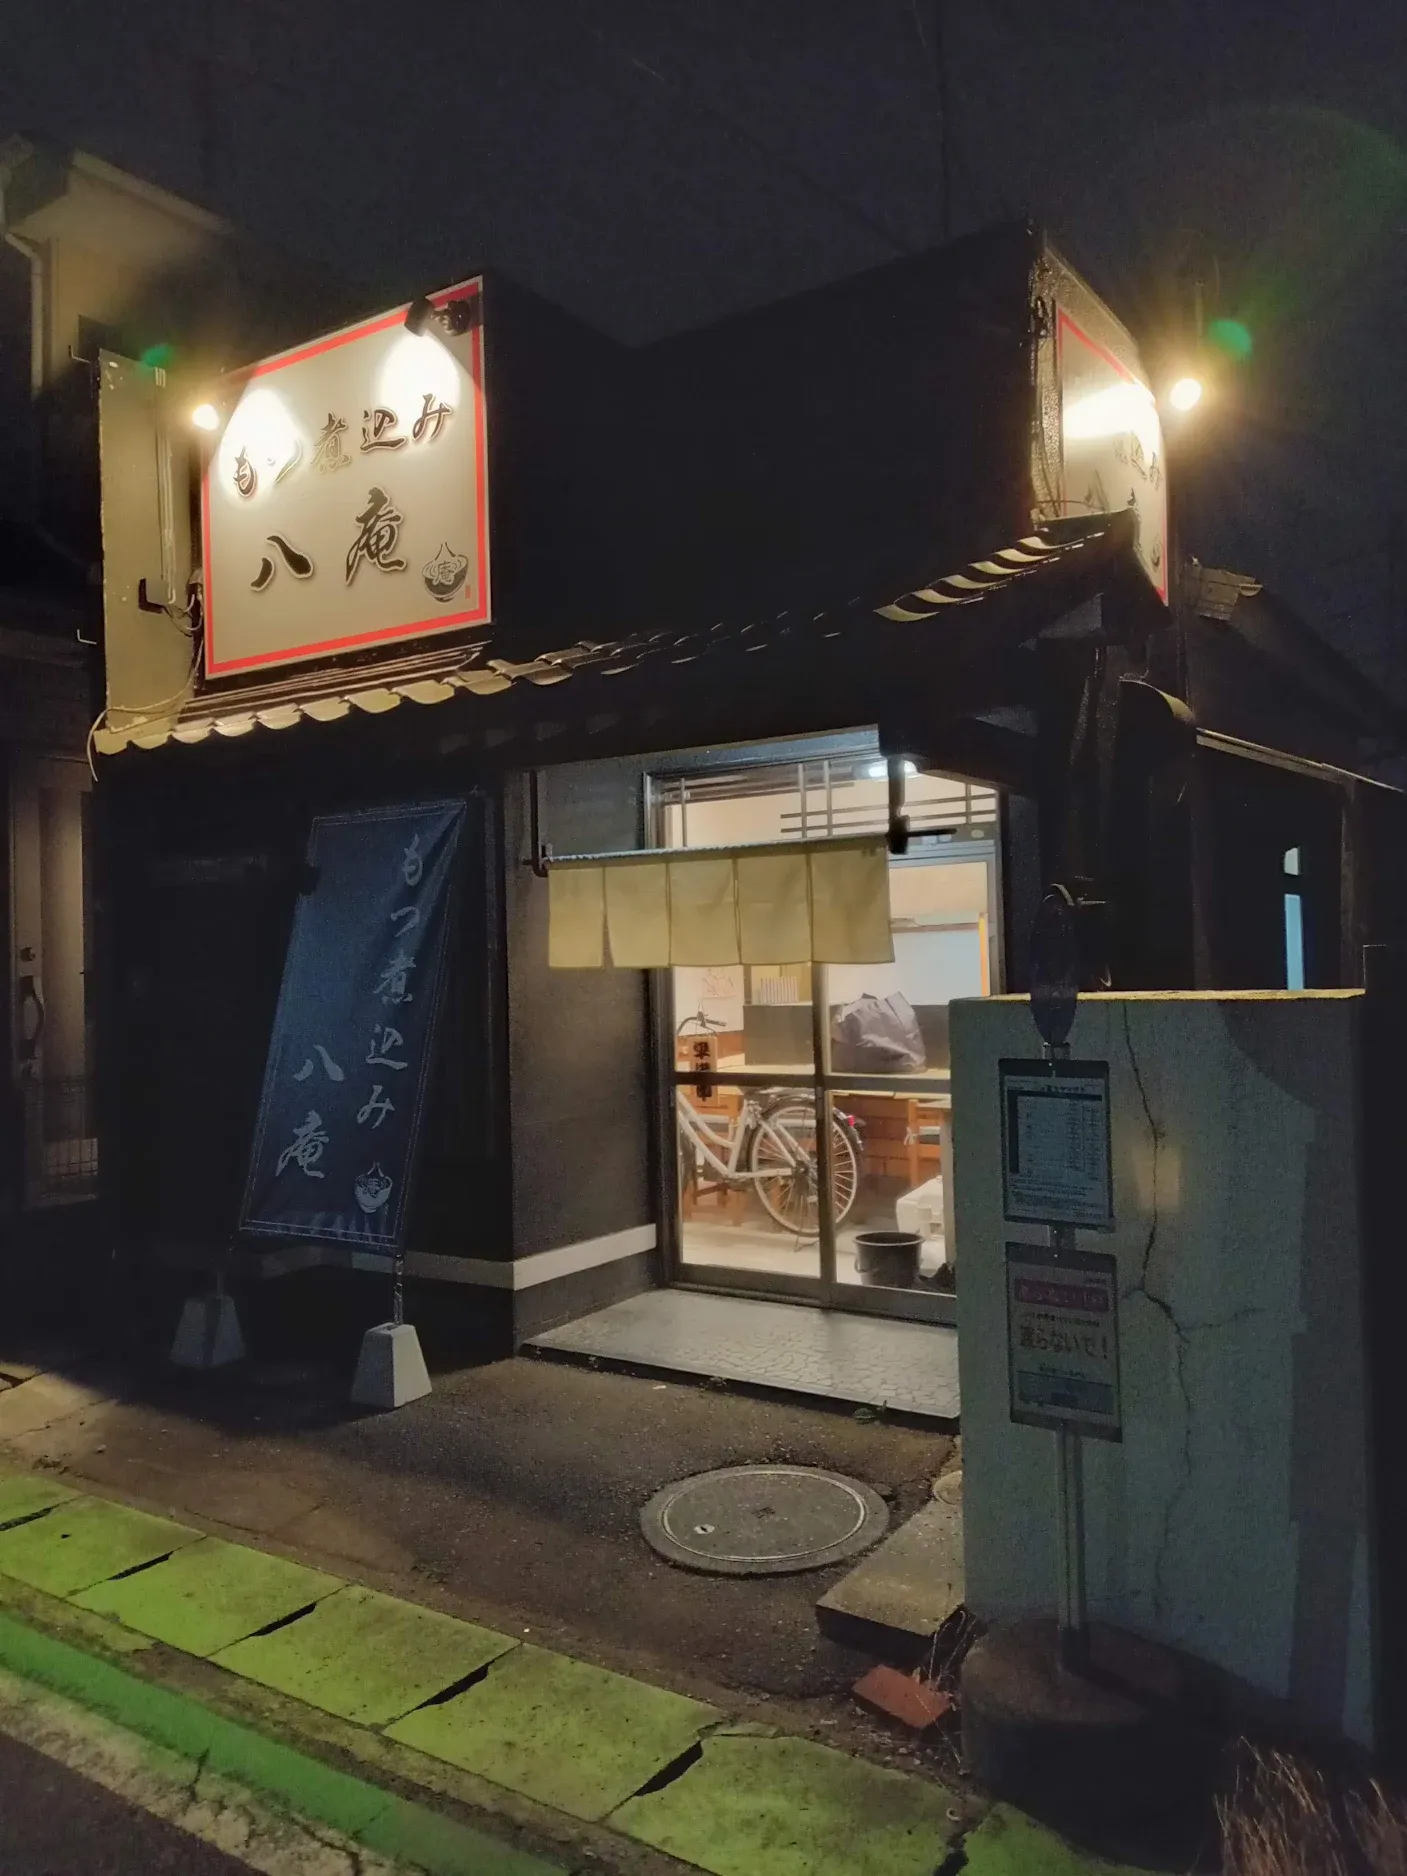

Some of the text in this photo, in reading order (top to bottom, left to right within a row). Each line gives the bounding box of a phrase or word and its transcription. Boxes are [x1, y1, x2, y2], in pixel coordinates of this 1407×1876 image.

[250, 486, 408, 588] 八庵
[357, 834, 424, 1129] もつ煮込み
[275, 1043, 345, 1178] 八庵
